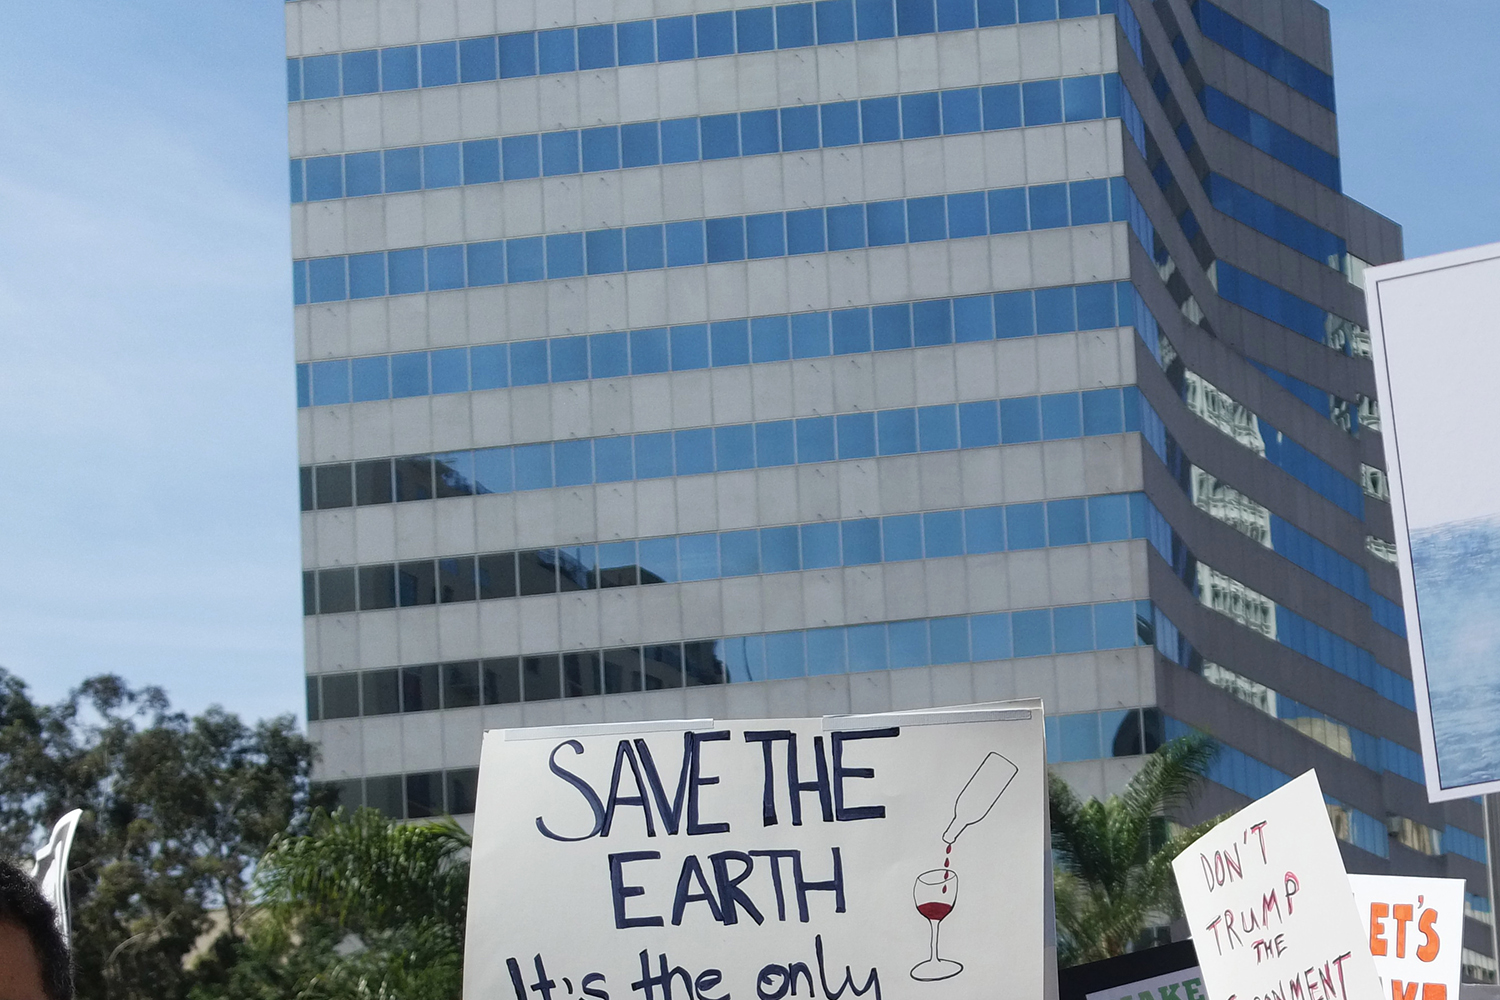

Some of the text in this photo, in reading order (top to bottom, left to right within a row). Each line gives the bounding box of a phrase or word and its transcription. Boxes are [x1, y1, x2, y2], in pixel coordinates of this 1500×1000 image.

[534, 726, 901, 843] SAVE THE
[606, 846, 848, 930] EARTH
[1199, 820, 1269, 893] DON'T
[1205, 870, 1300, 957] TRUMP
[1250, 933, 1288, 966] THE
[1369, 894, 1441, 964] ET'S
